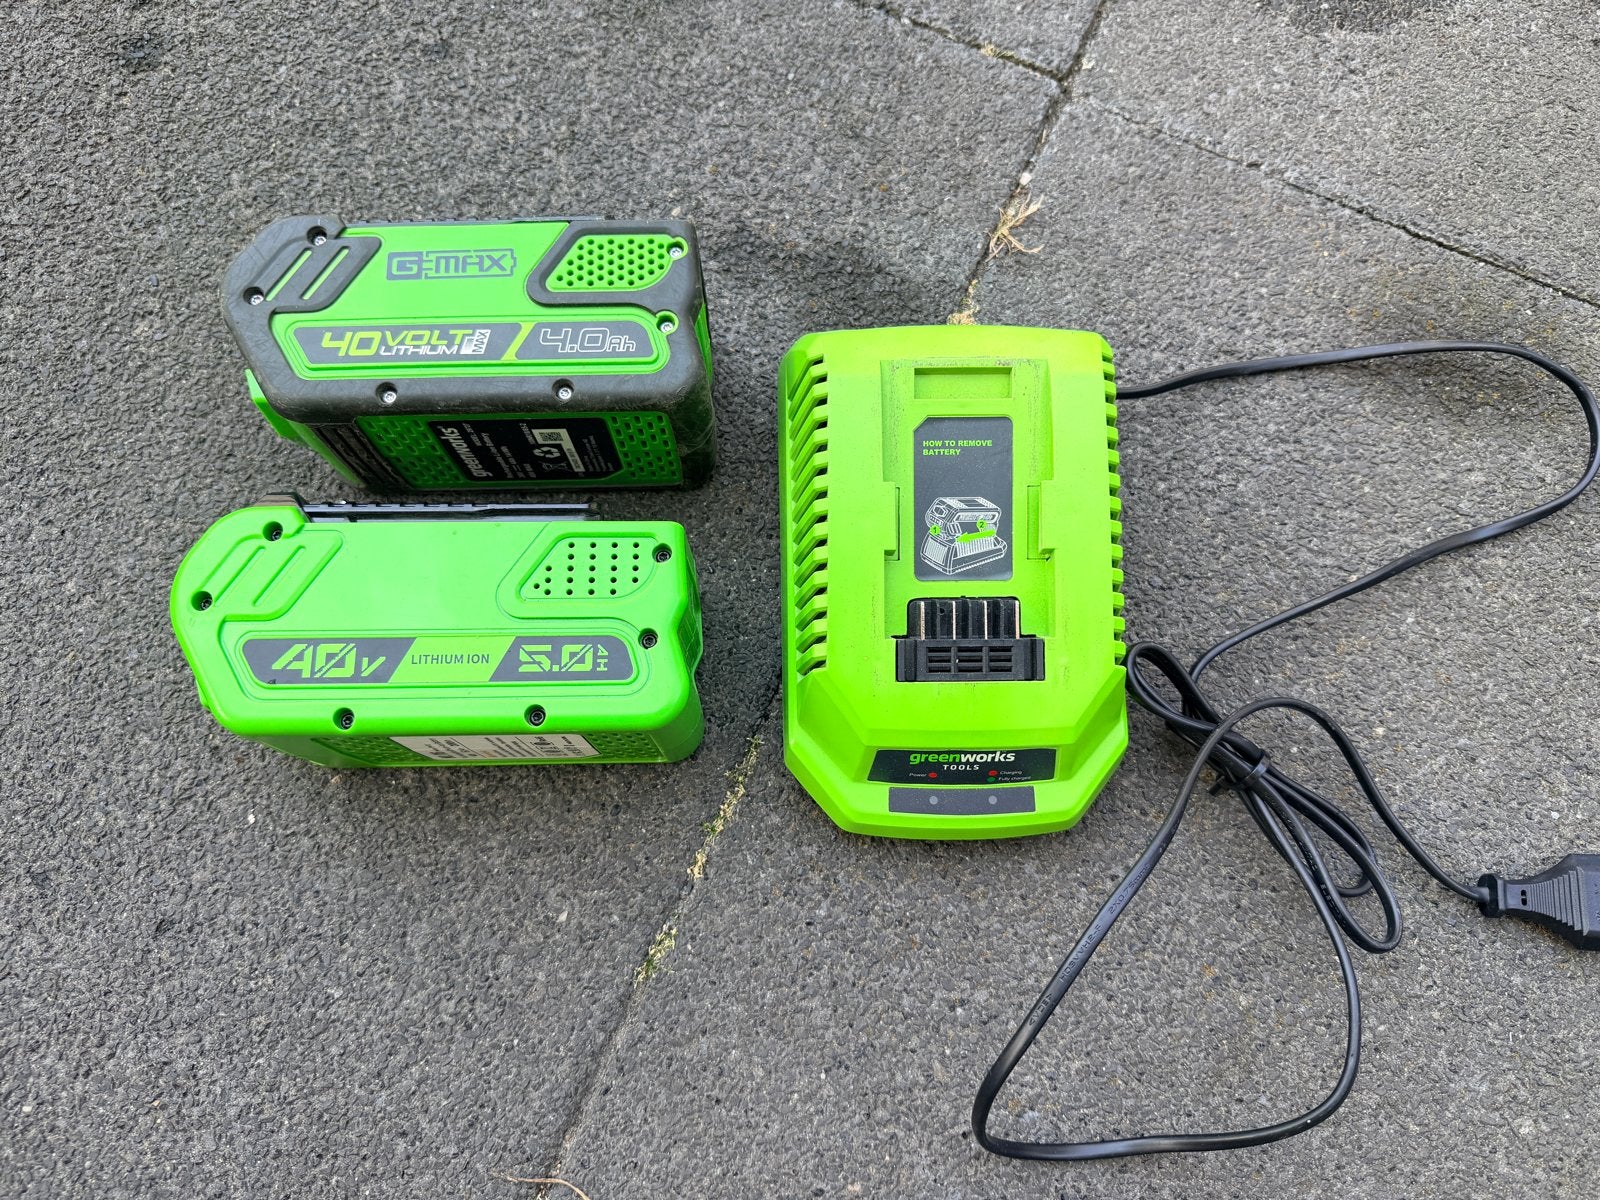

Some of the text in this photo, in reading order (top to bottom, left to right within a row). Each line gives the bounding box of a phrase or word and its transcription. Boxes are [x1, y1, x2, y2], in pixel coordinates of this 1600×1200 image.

[321, 329, 473, 357] 40 VOLT
[379, 345, 459, 356] LITHIUM
[472, 330, 490, 353] MAX
[440, 427, 493, 477] greenworks
[922, 448, 961, 456] BATTERY
[411, 653, 490, 665] LITHIUM ION
[518, 644, 594, 672] 5.0
[909, 751, 1016, 765] greenworks
